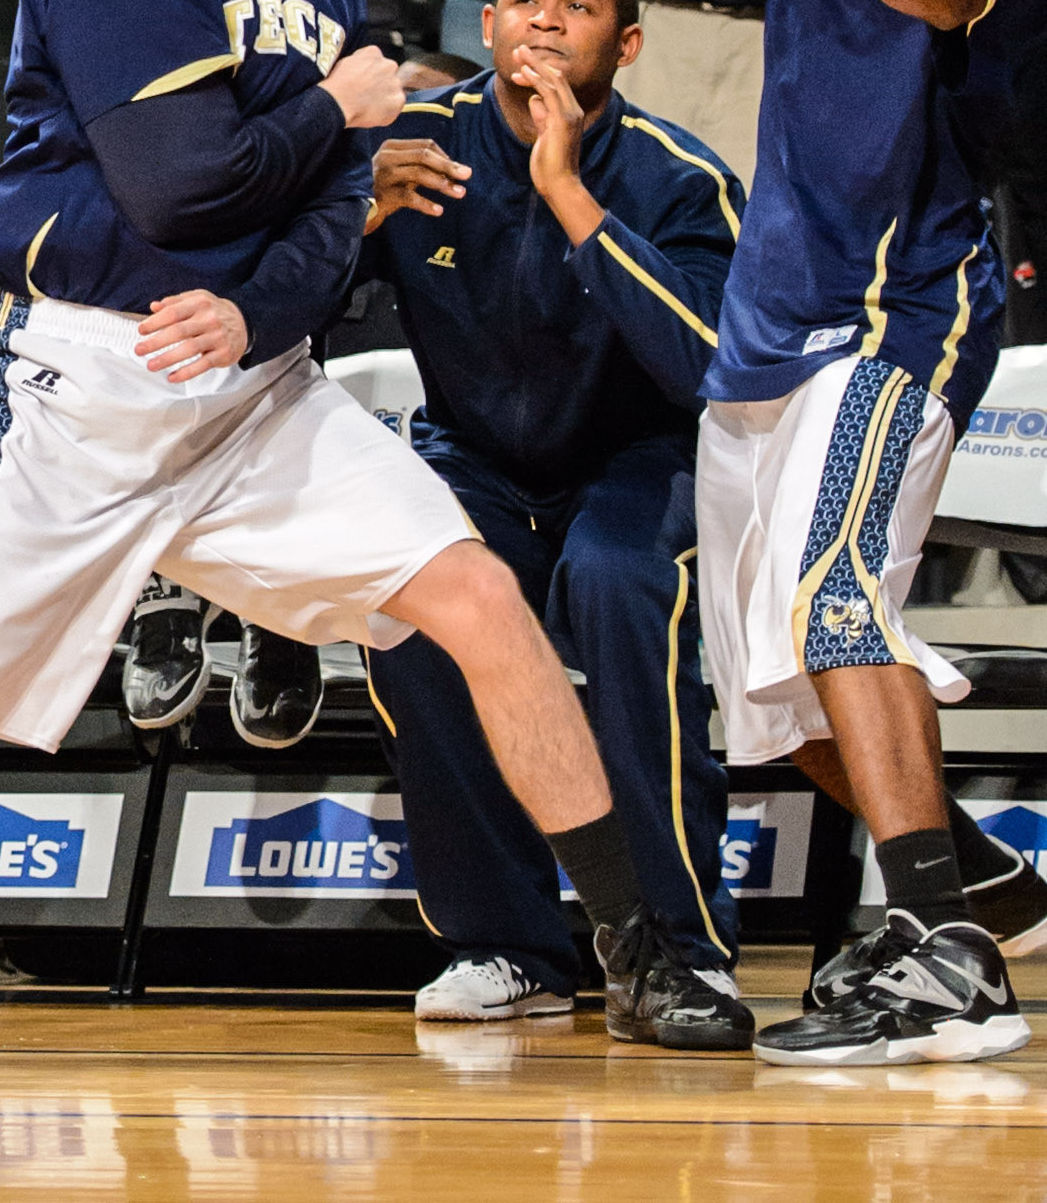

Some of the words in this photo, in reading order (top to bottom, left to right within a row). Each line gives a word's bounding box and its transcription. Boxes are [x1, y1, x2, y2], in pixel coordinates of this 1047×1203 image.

[965, 406, 1047, 440] aro
[957, 440, 1047, 458] Aarons.co
[229, 833, 402, 879] LOWE'S
